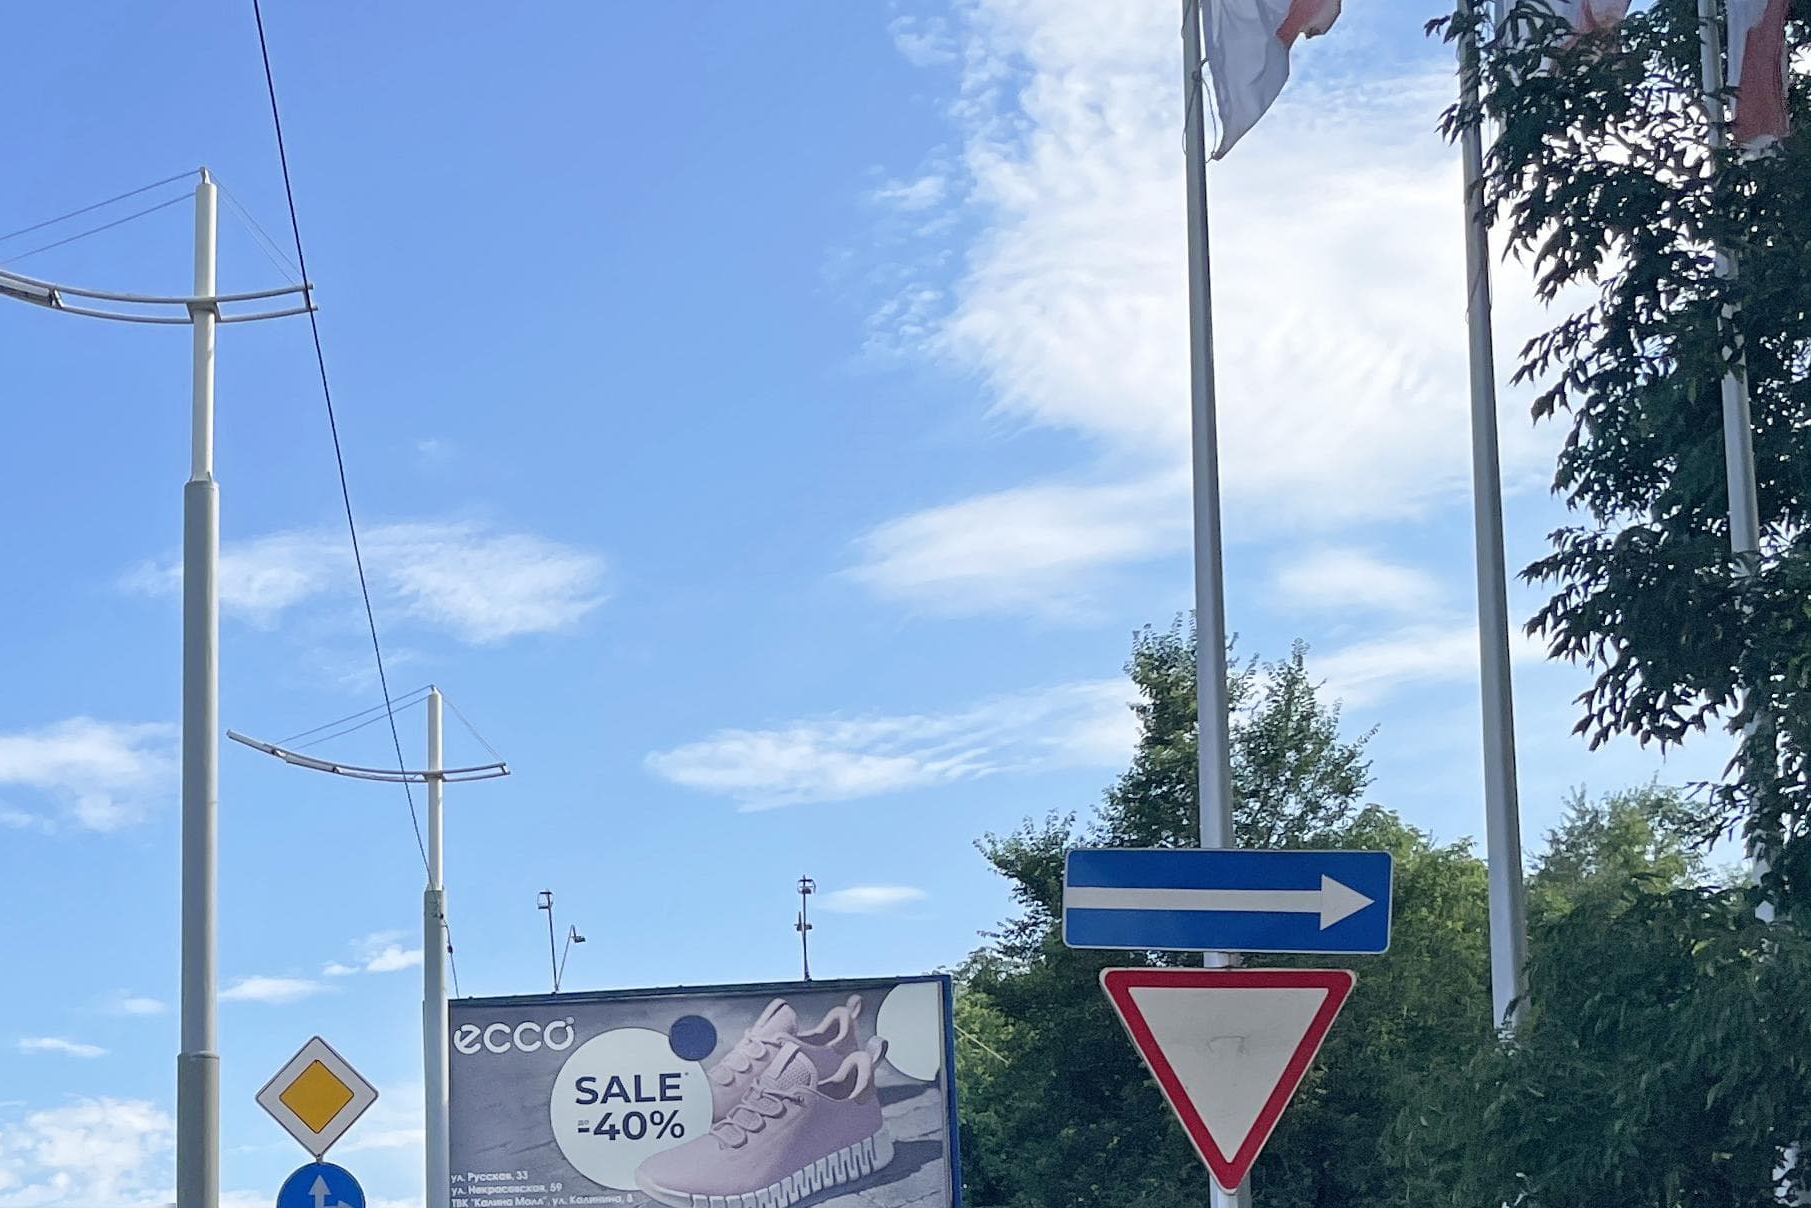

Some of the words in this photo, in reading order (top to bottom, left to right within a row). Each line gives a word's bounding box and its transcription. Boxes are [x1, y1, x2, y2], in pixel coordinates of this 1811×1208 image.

[453, 1016, 575, 1055] ecco
[575, 1072, 683, 1105] SALE
[577, 1109, 685, 1141] -40%
[516, 1171, 529, 1181] 33
